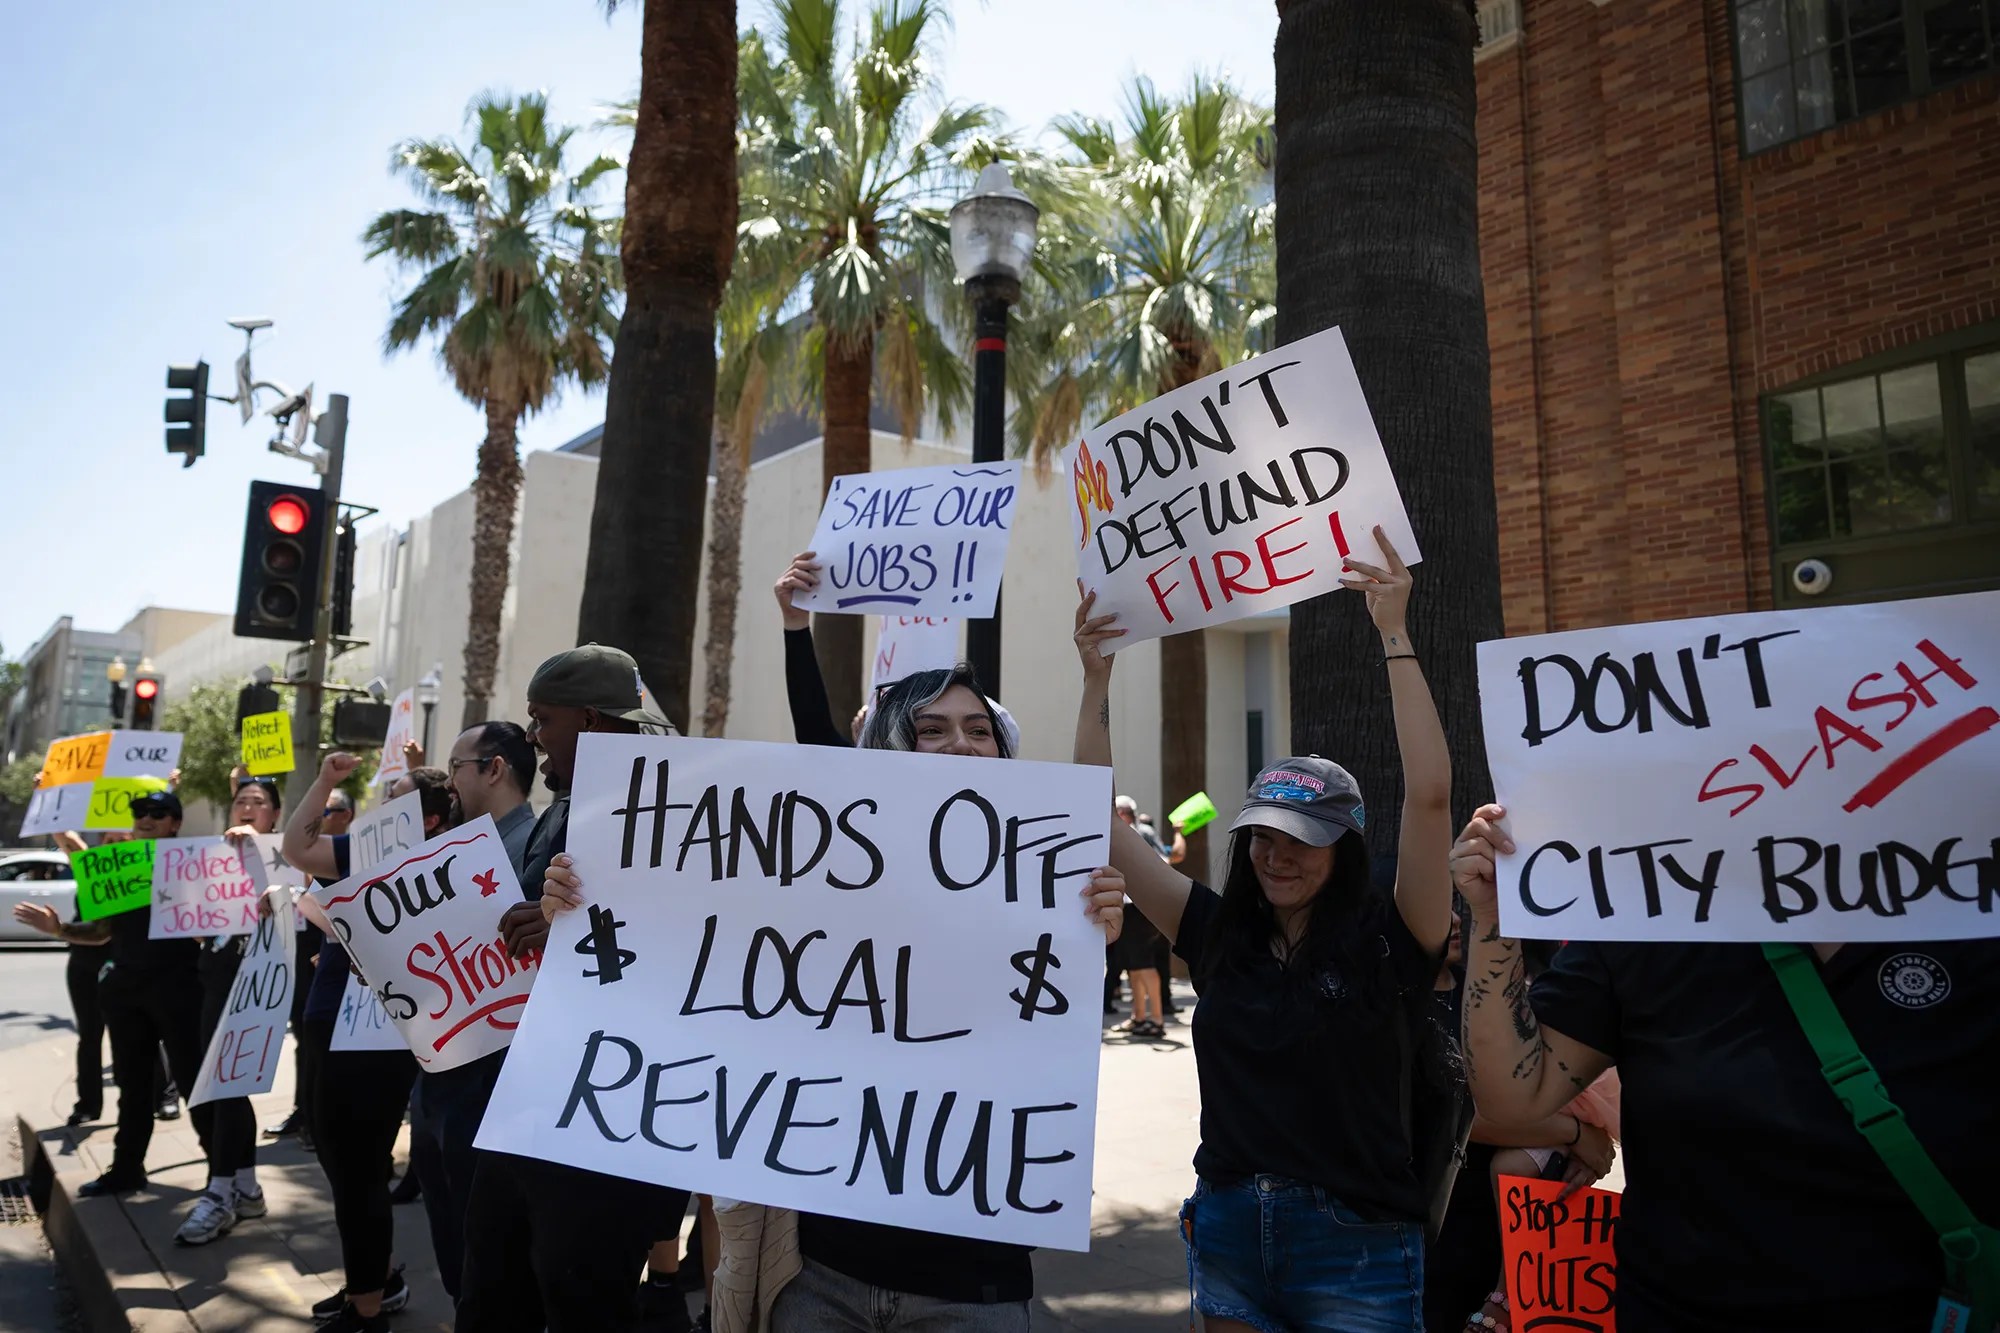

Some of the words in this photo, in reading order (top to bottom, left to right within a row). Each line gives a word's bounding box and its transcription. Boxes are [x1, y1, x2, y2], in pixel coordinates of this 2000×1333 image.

[1105, 361, 1302, 498] DON'T
[832, 484, 934, 530] SAVE
[933, 485, 1015, 530] OUR
[1095, 446, 1350, 575] DEFUND
[1517, 630, 1800, 747] DON'T
[1698, 638, 1978, 818] SLASH
[45, 741, 106, 777] SAVE
[125, 745, 170, 762] OUR
[79, 841, 155, 879] Protect
[163, 840, 257, 882] Protect
[611, 755, 884, 890] HANDS
[929, 788, 1104, 908] OFF
[160, 902, 230, 933] Jobs
[364, 854, 457, 934] Our
[1518, 838, 1725, 923] CITY
[1752, 835, 2000, 924] BUDG
[679, 915, 972, 1043] LOCAL
[555, 1030, 1078, 1216] REVENUE
[1507, 1184, 1570, 1249] Stop
[1516, 1250, 1616, 1314] CUTS
